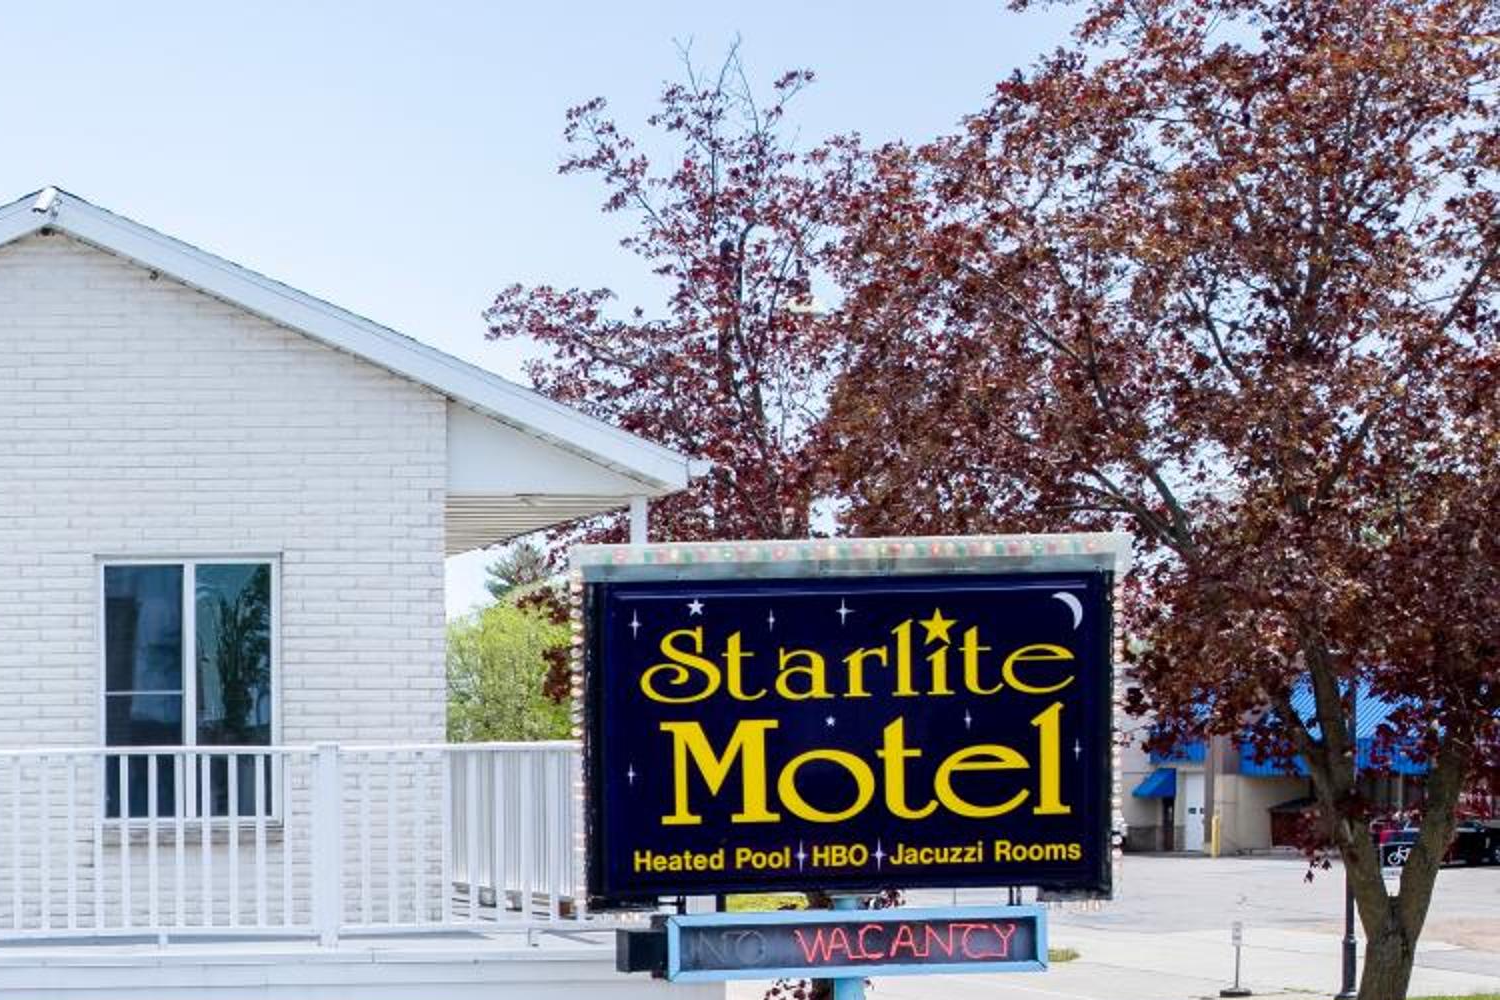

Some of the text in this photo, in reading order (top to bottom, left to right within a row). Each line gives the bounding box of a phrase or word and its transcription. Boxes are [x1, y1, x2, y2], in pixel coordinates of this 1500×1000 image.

[640, 608, 1074, 703] Starlite
[659, 702, 1072, 825] Motel
[634, 839, 1081, 872] Heated Pool HBO Jacuzzi Rooms
[691, 921, 1017, 965] NO VACANCY
